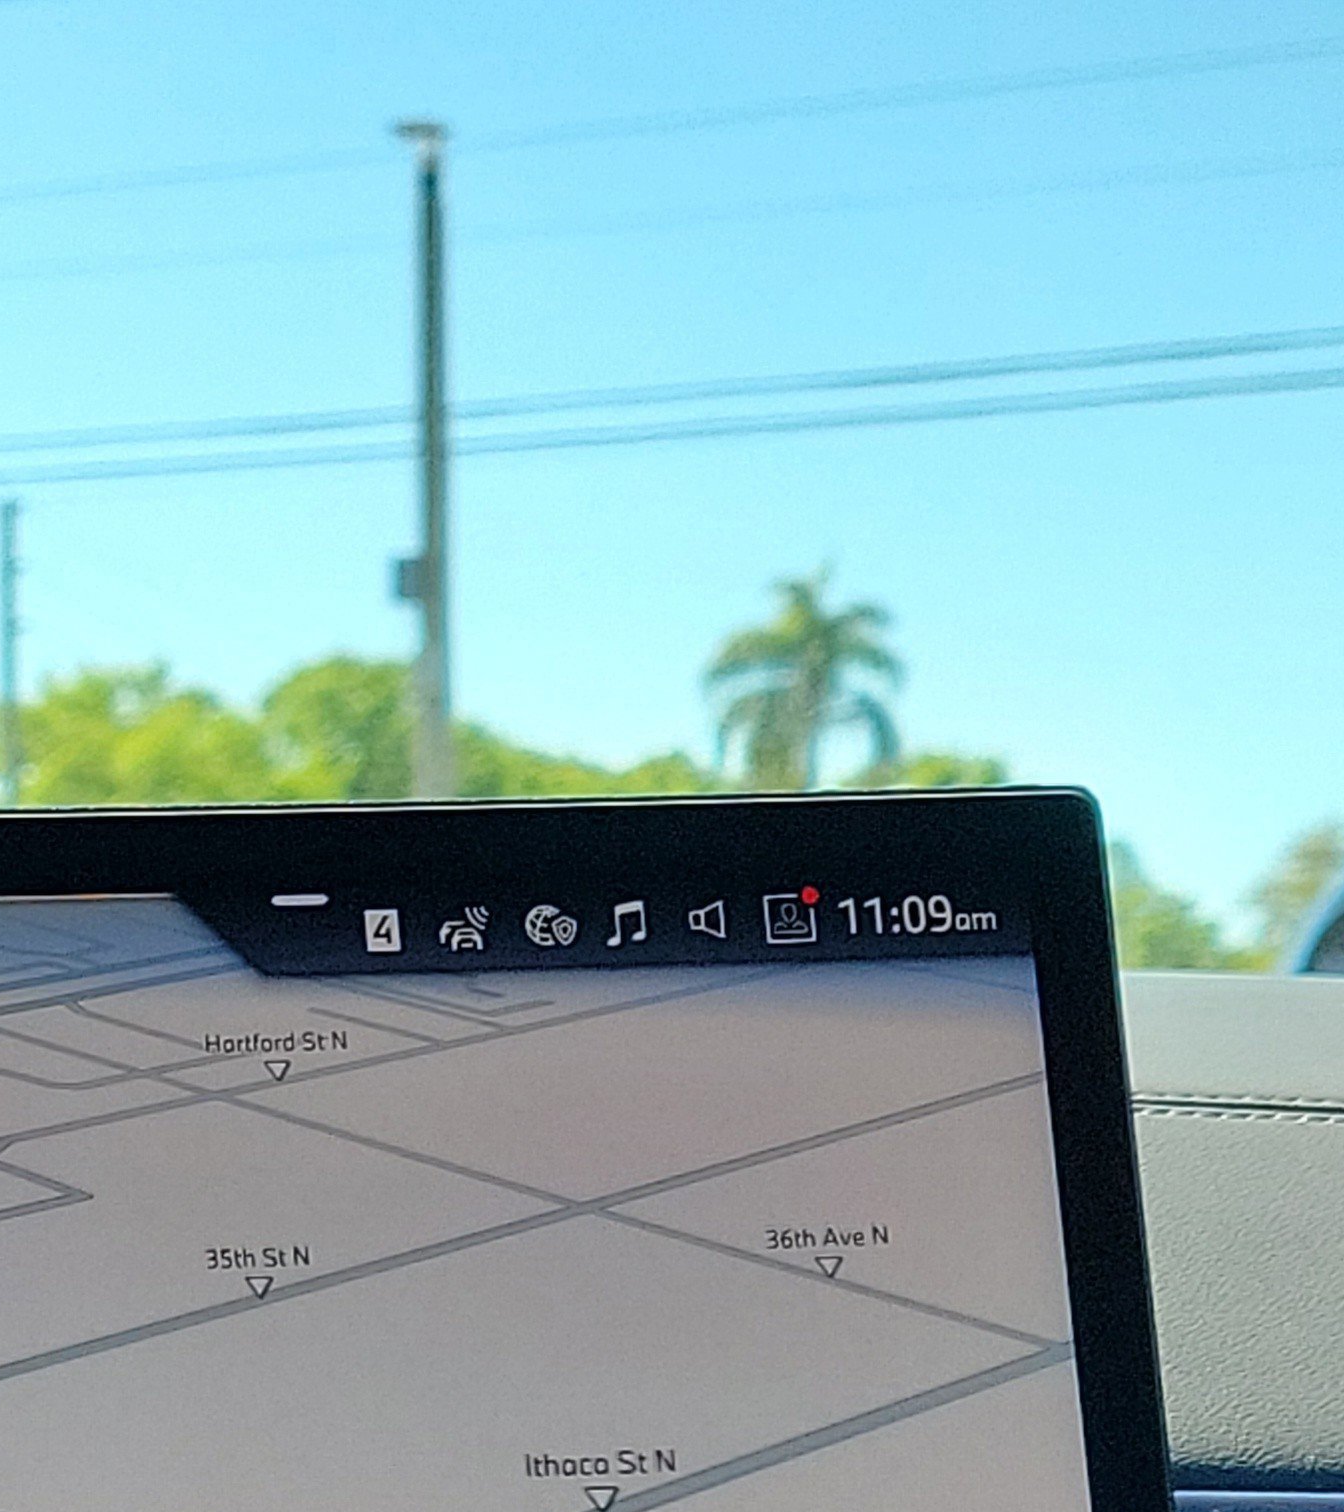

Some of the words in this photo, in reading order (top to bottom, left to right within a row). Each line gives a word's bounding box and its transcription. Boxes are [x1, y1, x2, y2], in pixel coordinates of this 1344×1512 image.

[373, 915, 392, 944] 4
[204, 1032, 295, 1053] Hartford
[301, 1031, 326, 1050] St
[331, 1030, 348, 1050] N
[765, 1228, 816, 1250] 36th
[823, 1227, 866, 1247] Ave
[872, 1226, 889, 1245] N
[206, 1248, 256, 1270] 35th
[262, 1247, 286, 1267] St
[293, 1246, 310, 1266] N
[524, 1453, 610, 1477] Ithaca
[617, 1450, 648, 1475] St
[655, 1449, 676, 1472] N
